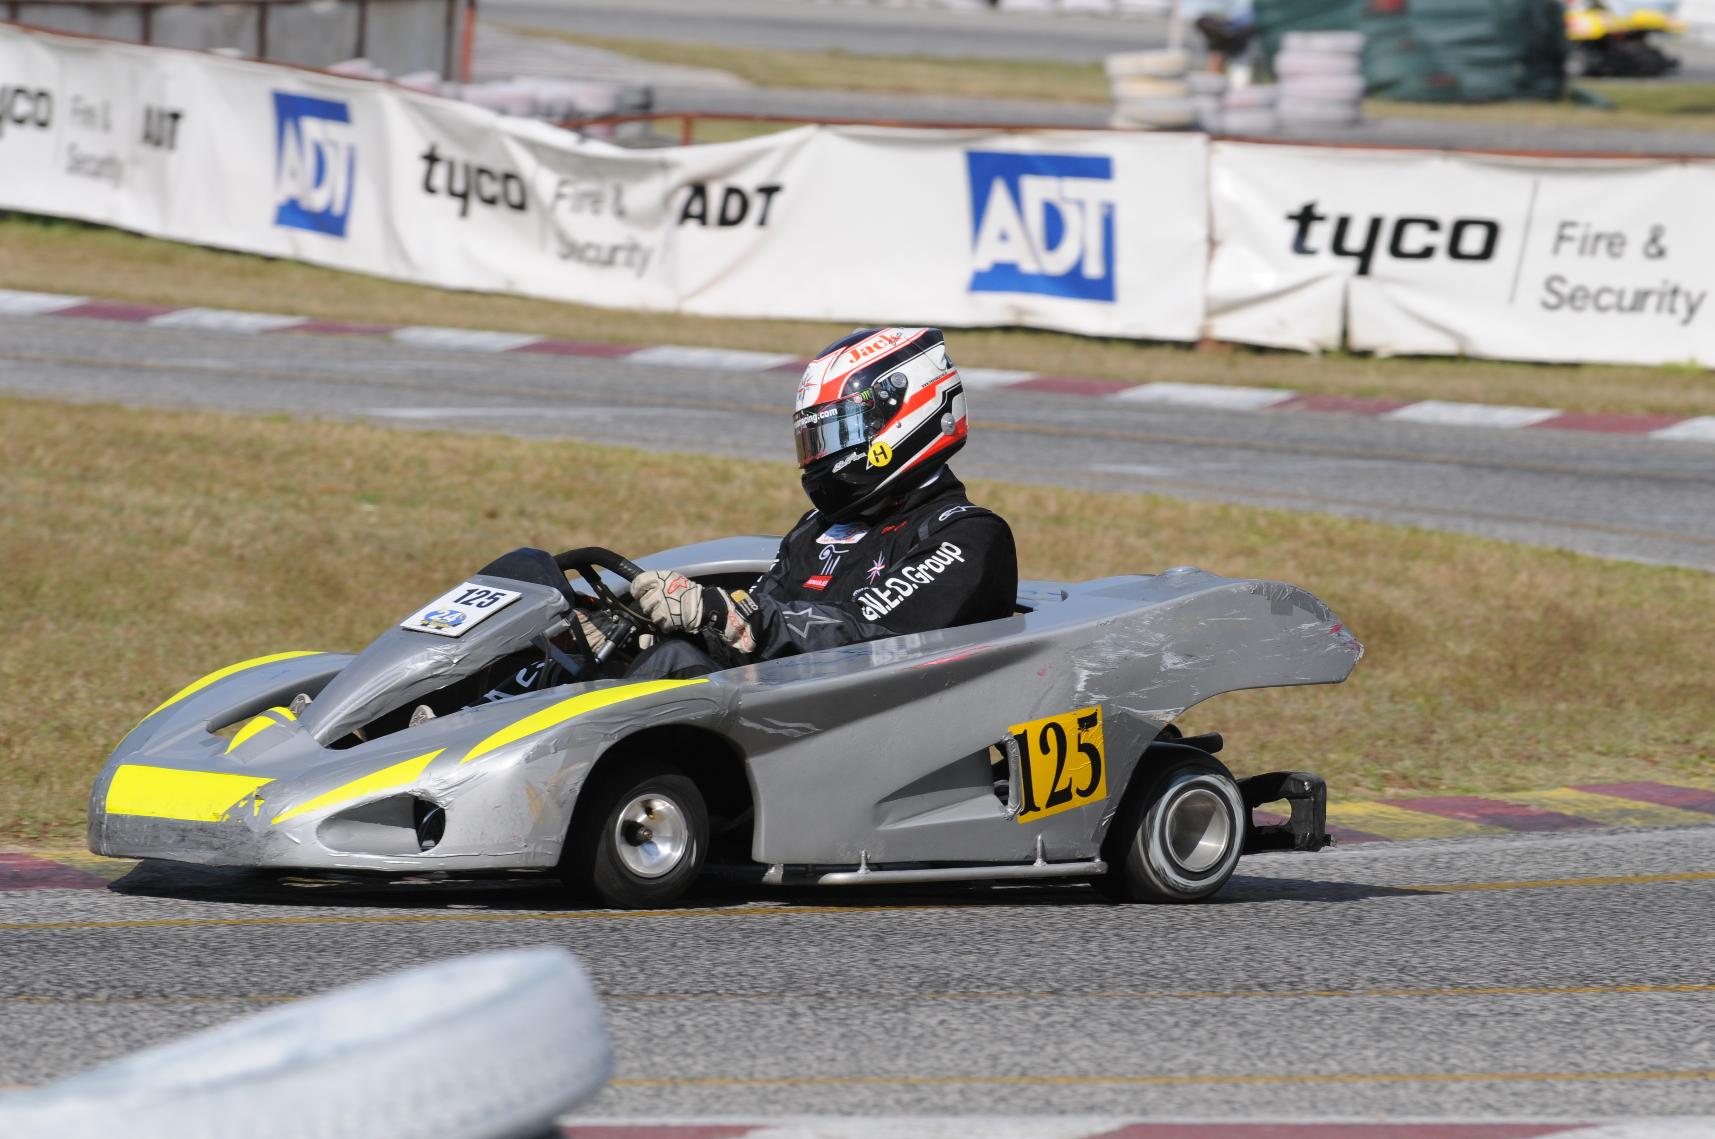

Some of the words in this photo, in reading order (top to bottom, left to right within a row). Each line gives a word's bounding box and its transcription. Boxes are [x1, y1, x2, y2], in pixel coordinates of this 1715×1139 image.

[275, 113, 356, 218] ADT
[421, 142, 527, 218] tyco
[678, 183, 785, 228] ADT
[970, 174, 1114, 280] ADT
[1285, 201, 1501, 277] tyco
[1551, 220, 1627, 258] Fire
[1642, 223, 1667, 260] &
[1540, 273, 1707, 327] Security
[453, 588, 507, 608] 125
[1013, 708, 1103, 818] 125
